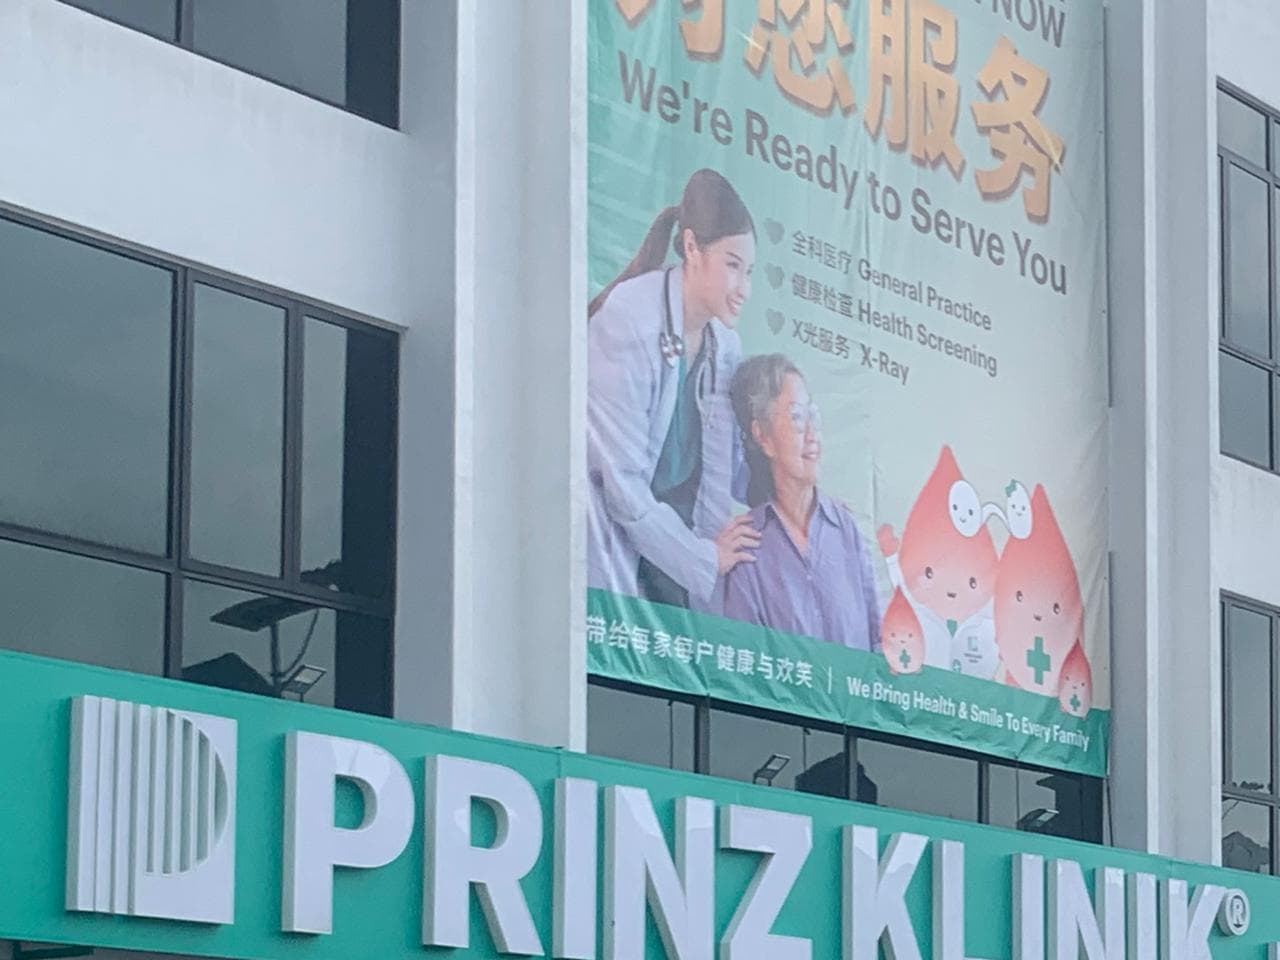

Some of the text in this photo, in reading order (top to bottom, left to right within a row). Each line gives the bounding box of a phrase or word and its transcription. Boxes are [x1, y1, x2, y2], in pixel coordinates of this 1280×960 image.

[618, 50, 1068, 296] We're Ready to Serve You
[792, 230, 992, 331] 全科医疗 General Practice
[792, 272, 998, 378] 健康检查 Health Screening
[792, 318, 910, 386] X光服务 X-Ray
[847, 675, 1090, 752] We Bring Health & Smile To Every Family
